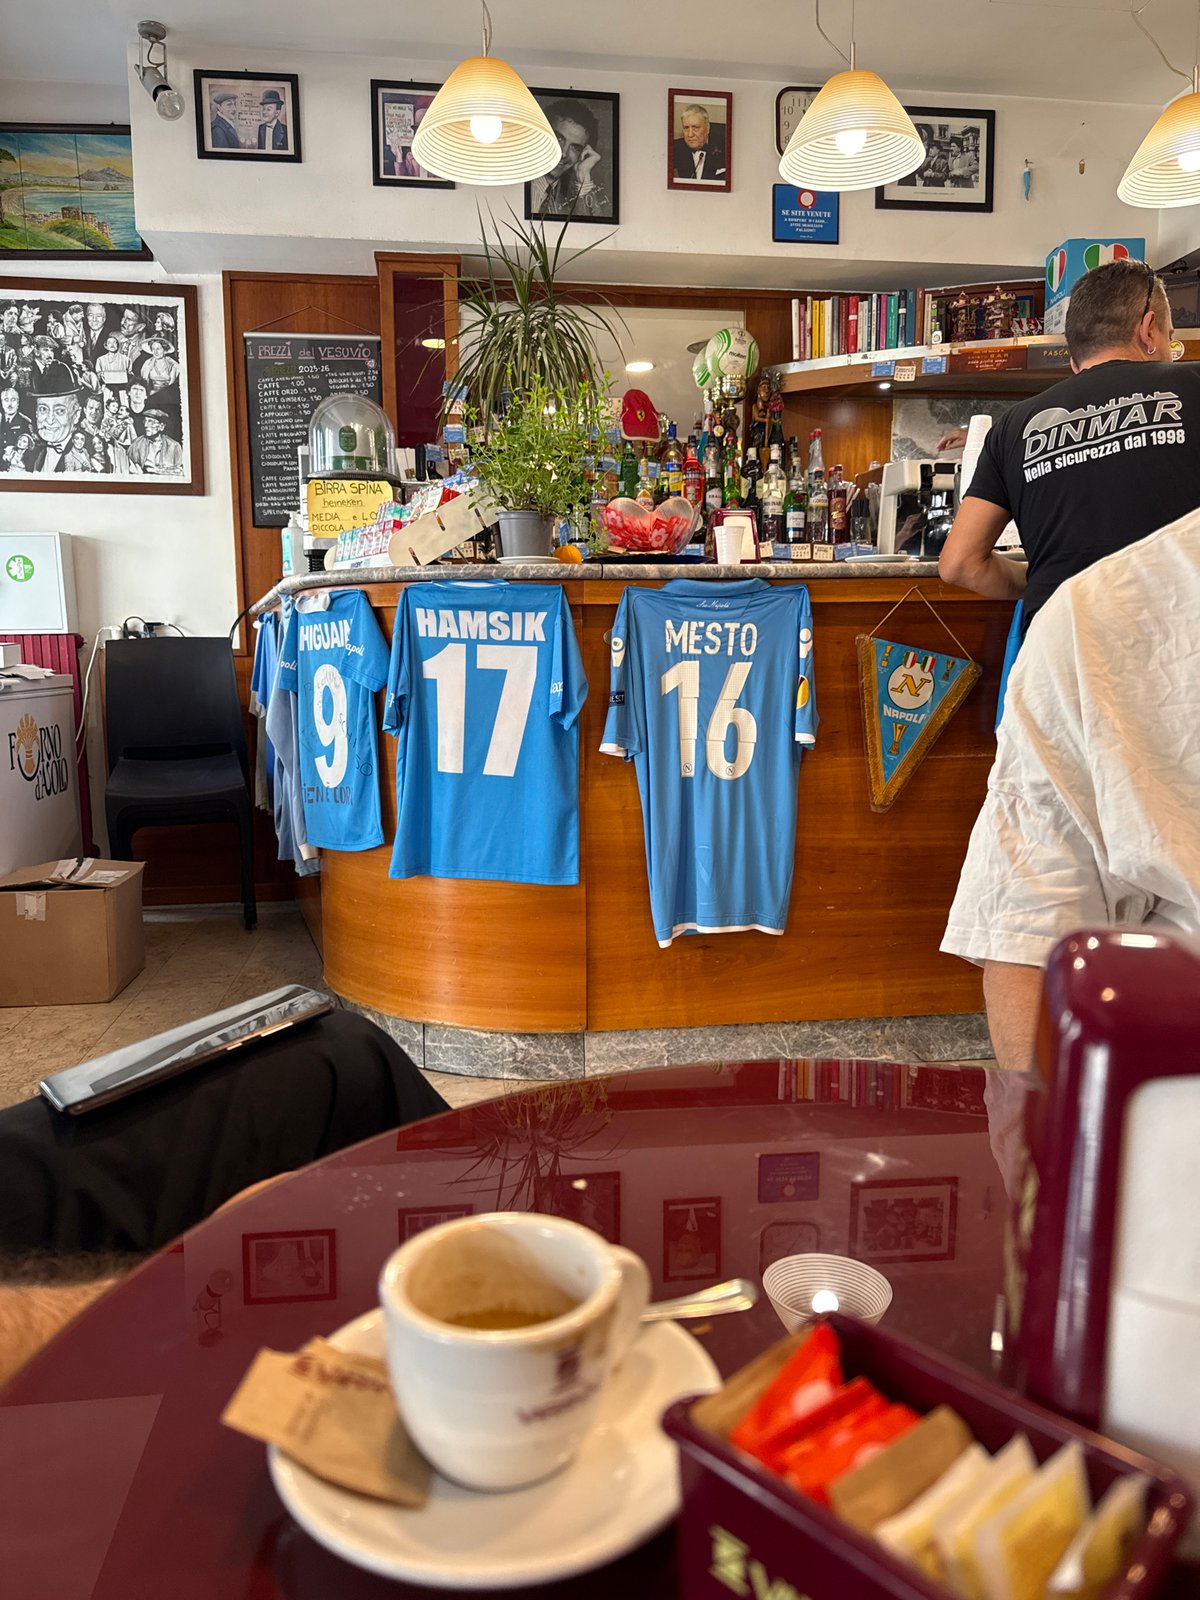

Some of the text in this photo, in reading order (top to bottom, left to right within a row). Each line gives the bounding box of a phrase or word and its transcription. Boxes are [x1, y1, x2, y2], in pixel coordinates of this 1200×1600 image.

[783, 106, 794, 115] 10
[784, 120, 790, 130] 9
[298, 347, 315, 357] del
[1043, 348, 1070, 356] PASCA
[1024, 399, 1183, 461] DINMAR
[1024, 428, 1186, 483] Nella sicurezza dal 1998
[323, 497, 364, 508] heineken
[311, 512, 341, 522] MEDIA
[312, 524, 345, 532] PICCOLA
[415, 607, 549, 642] HAMSIK
[664, 619, 758, 657] MESTO
[345, 642, 366, 657] apoli
[890, 673, 932, 697] N
[422, 642, 539, 778] 17
[660, 660, 758, 781] 16
[883, 703, 927, 725] NAPOLI
[313, 663, 349, 789] 9
